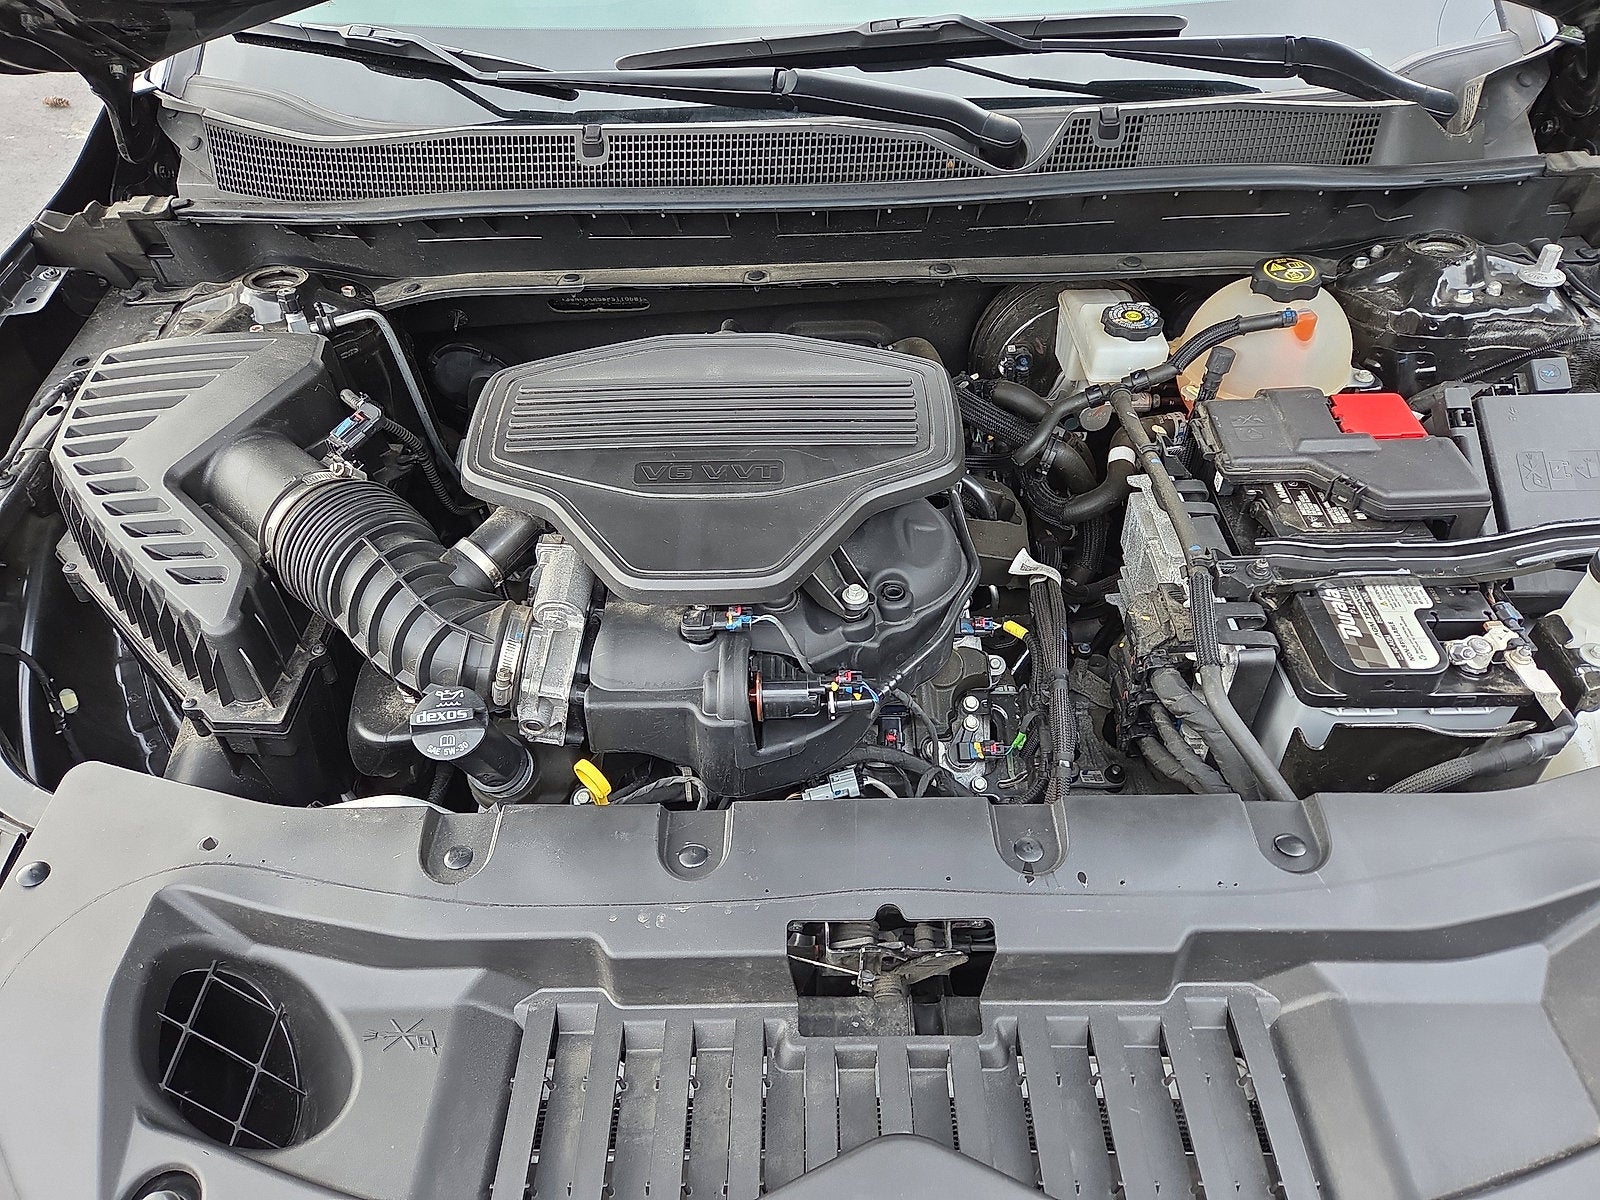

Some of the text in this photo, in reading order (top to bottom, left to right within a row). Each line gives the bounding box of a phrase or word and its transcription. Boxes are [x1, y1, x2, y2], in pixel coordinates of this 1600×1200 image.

[641, 464, 778, 480] V6 VVT
[1338, 588, 1359, 615] PLATIN
[1350, 586, 1374, 623] TECHNOLO
[1322, 588, 1364, 640] Durala
[416, 708, 468, 723] dexos
[426, 741, 469, 756] SAE 5W-30
